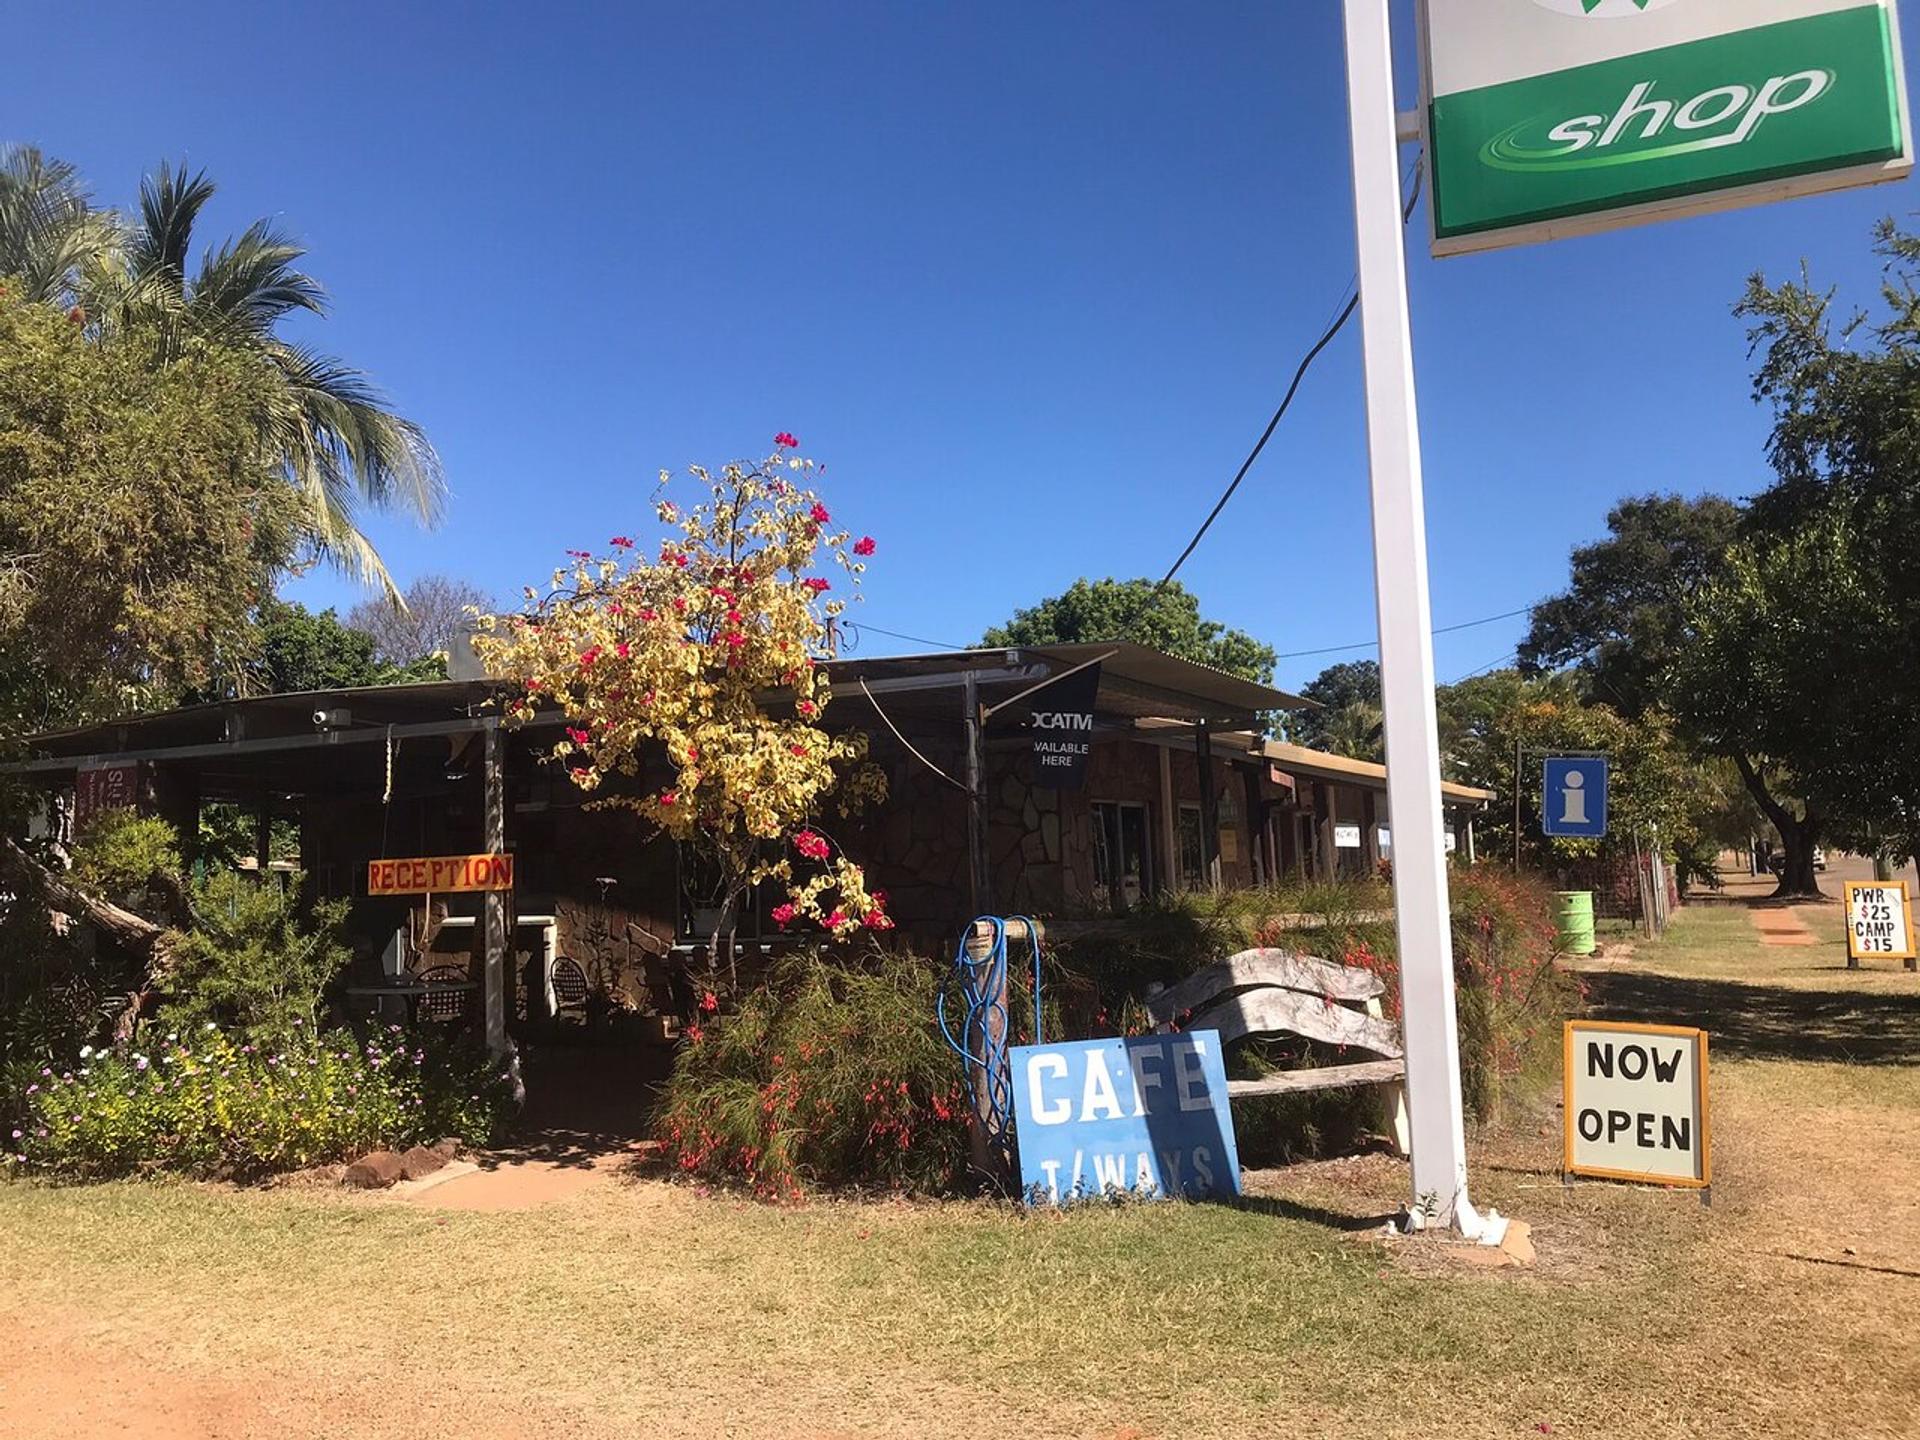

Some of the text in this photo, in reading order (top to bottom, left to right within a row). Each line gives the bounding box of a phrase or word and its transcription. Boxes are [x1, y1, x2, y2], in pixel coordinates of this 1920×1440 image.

[1547, 69, 1833, 150] shop
[1033, 742, 1089, 754] VAILABLE
[1042, 756, 1073, 767] HERE
[370, 857, 513, 889] RECEPTION
[1852, 888, 1885, 903] PWR
[1861, 905, 1891, 920] $25
[1855, 922, 1895, 937] CAMP
[1863, 938, 1893, 952] $15
[1587, 1042, 1683, 1083] NOW
[1027, 1041, 1216, 1126] CAFE
[1578, 1108, 1690, 1151] OPEN
[1040, 1147, 1214, 1204] T/WAYS
